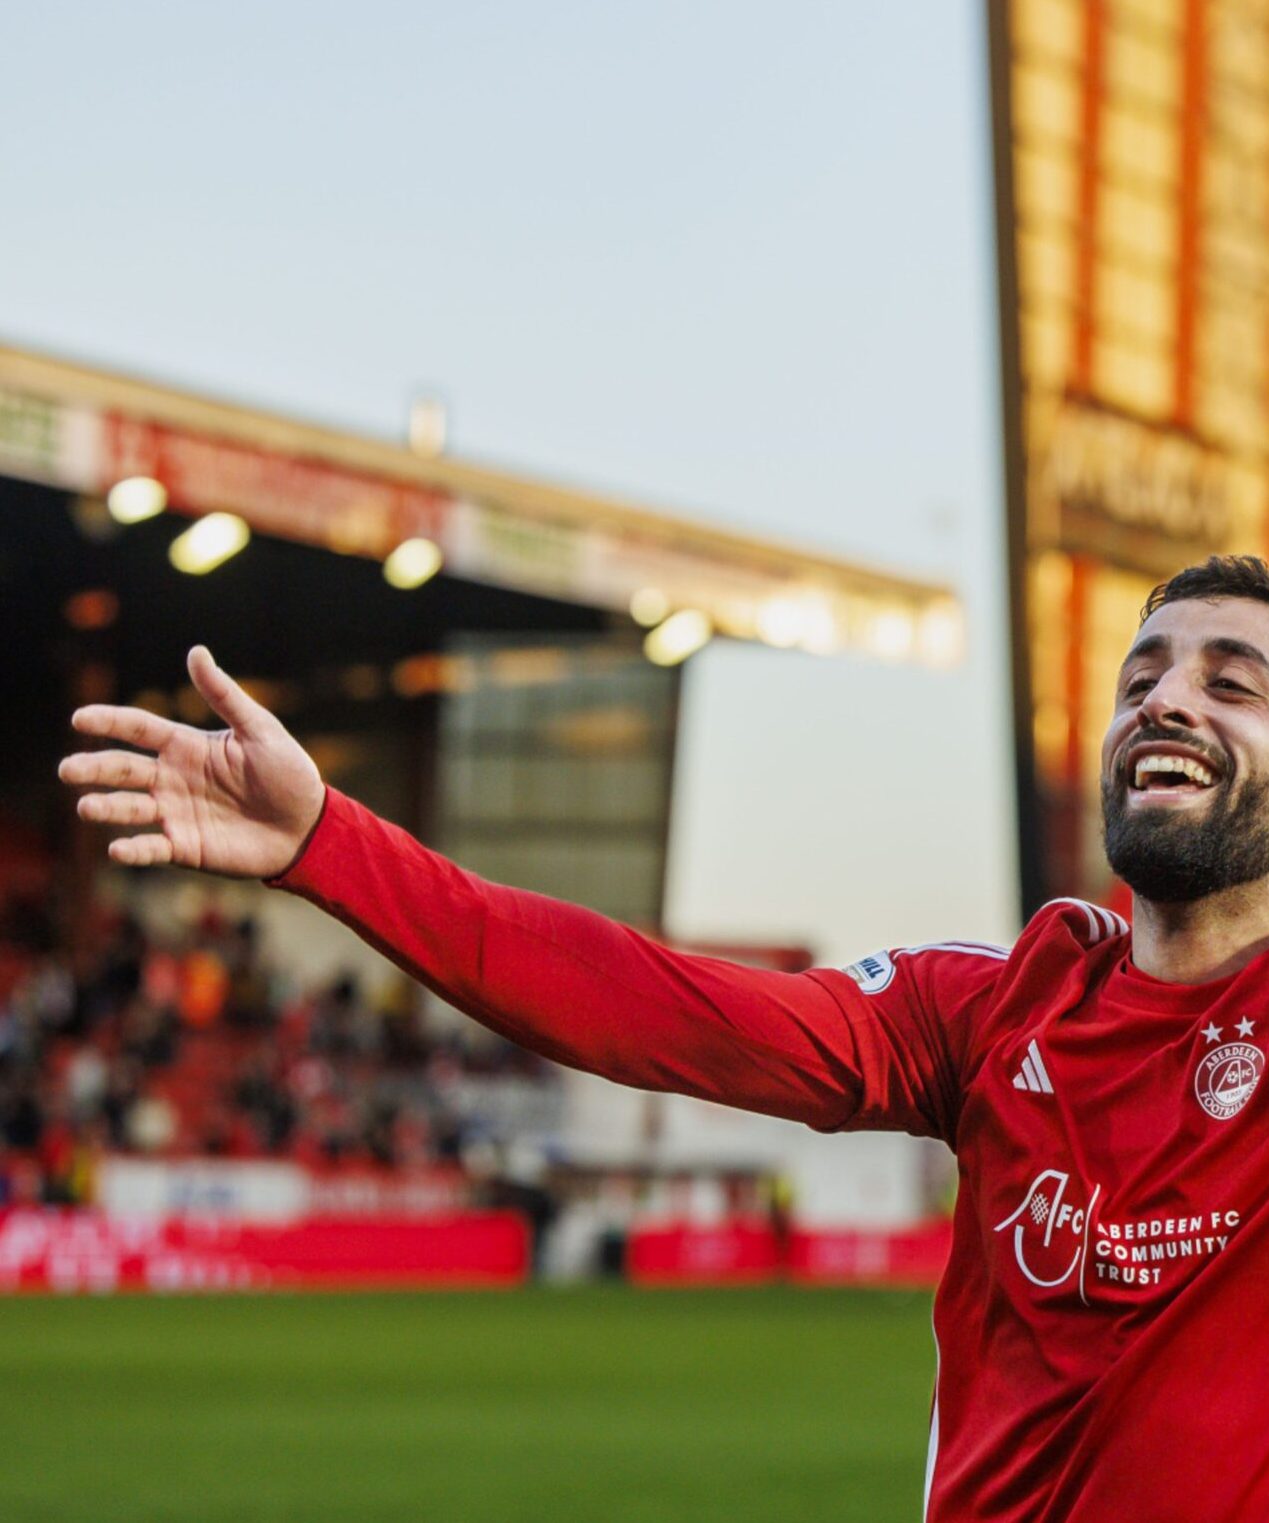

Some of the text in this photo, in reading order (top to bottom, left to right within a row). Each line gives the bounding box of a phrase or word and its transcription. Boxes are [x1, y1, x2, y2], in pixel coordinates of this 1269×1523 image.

[1205, 1046, 1259, 1071] ABERDEEN
[1097, 1210, 1240, 1240] ABERDEEN FC
[1095, 1236, 1229, 1262] COMMUNITY
[1095, 1263, 1161, 1285] TRUST
